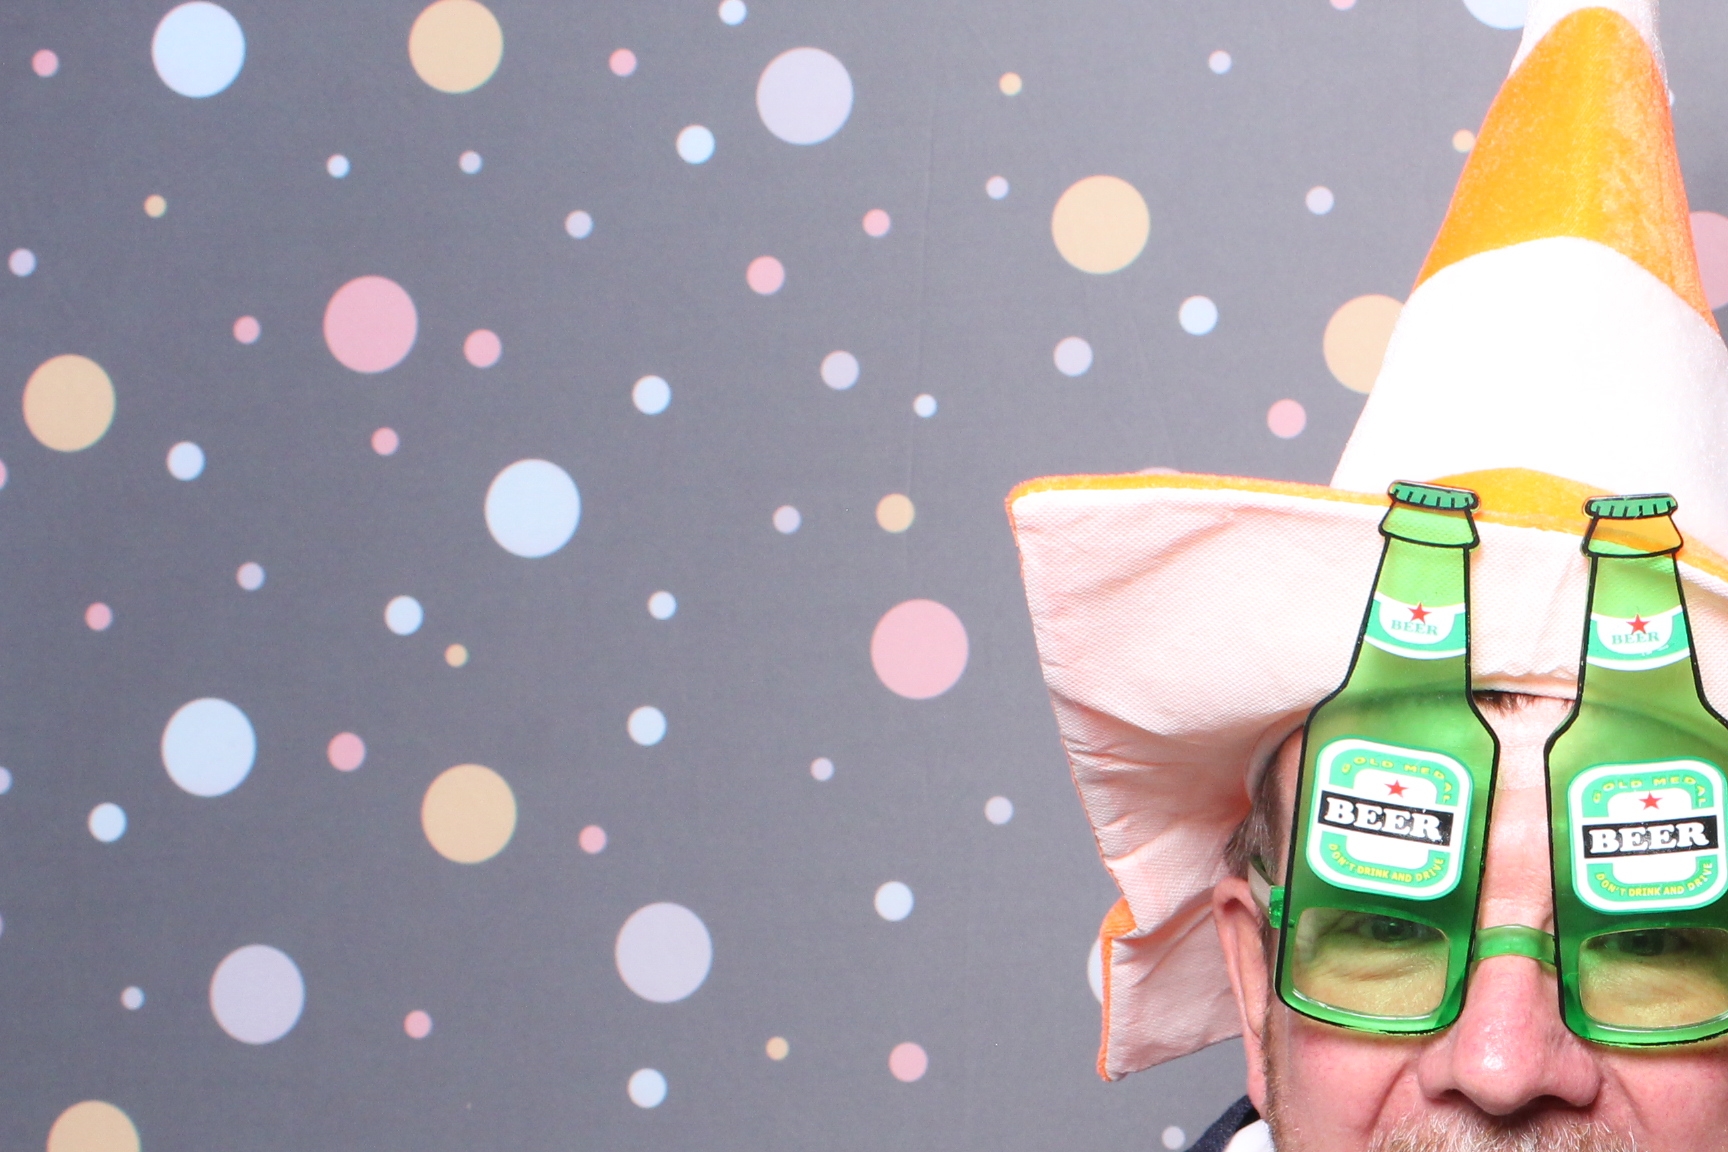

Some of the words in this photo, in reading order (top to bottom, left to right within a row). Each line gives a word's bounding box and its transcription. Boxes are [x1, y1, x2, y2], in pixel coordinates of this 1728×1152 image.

[1391, 619, 1438, 635] BEER
[1611, 631, 1660, 645] BEER
[1341, 756, 1394, 774] GOLD
[1403, 763, 1452, 802] MEDAL
[1592, 779, 1643, 804] GOLD
[1653, 775, 1706, 807] MEDAL
[1323, 796, 1443, 842] BEER
[1588, 821, 1710, 854] BEER
[1328, 843, 1356, 873] DON'T
[1357, 866, 1389, 879] DRINK
[1391, 870, 1413, 883] AND
[1415, 857, 1444, 882] DRIVE
[1595, 872, 1627, 896] DON'T
[1628, 885, 1661, 897] DRINK
[1663, 884, 1685, 896] AND
[1687, 862, 1713, 891] DRIVE
